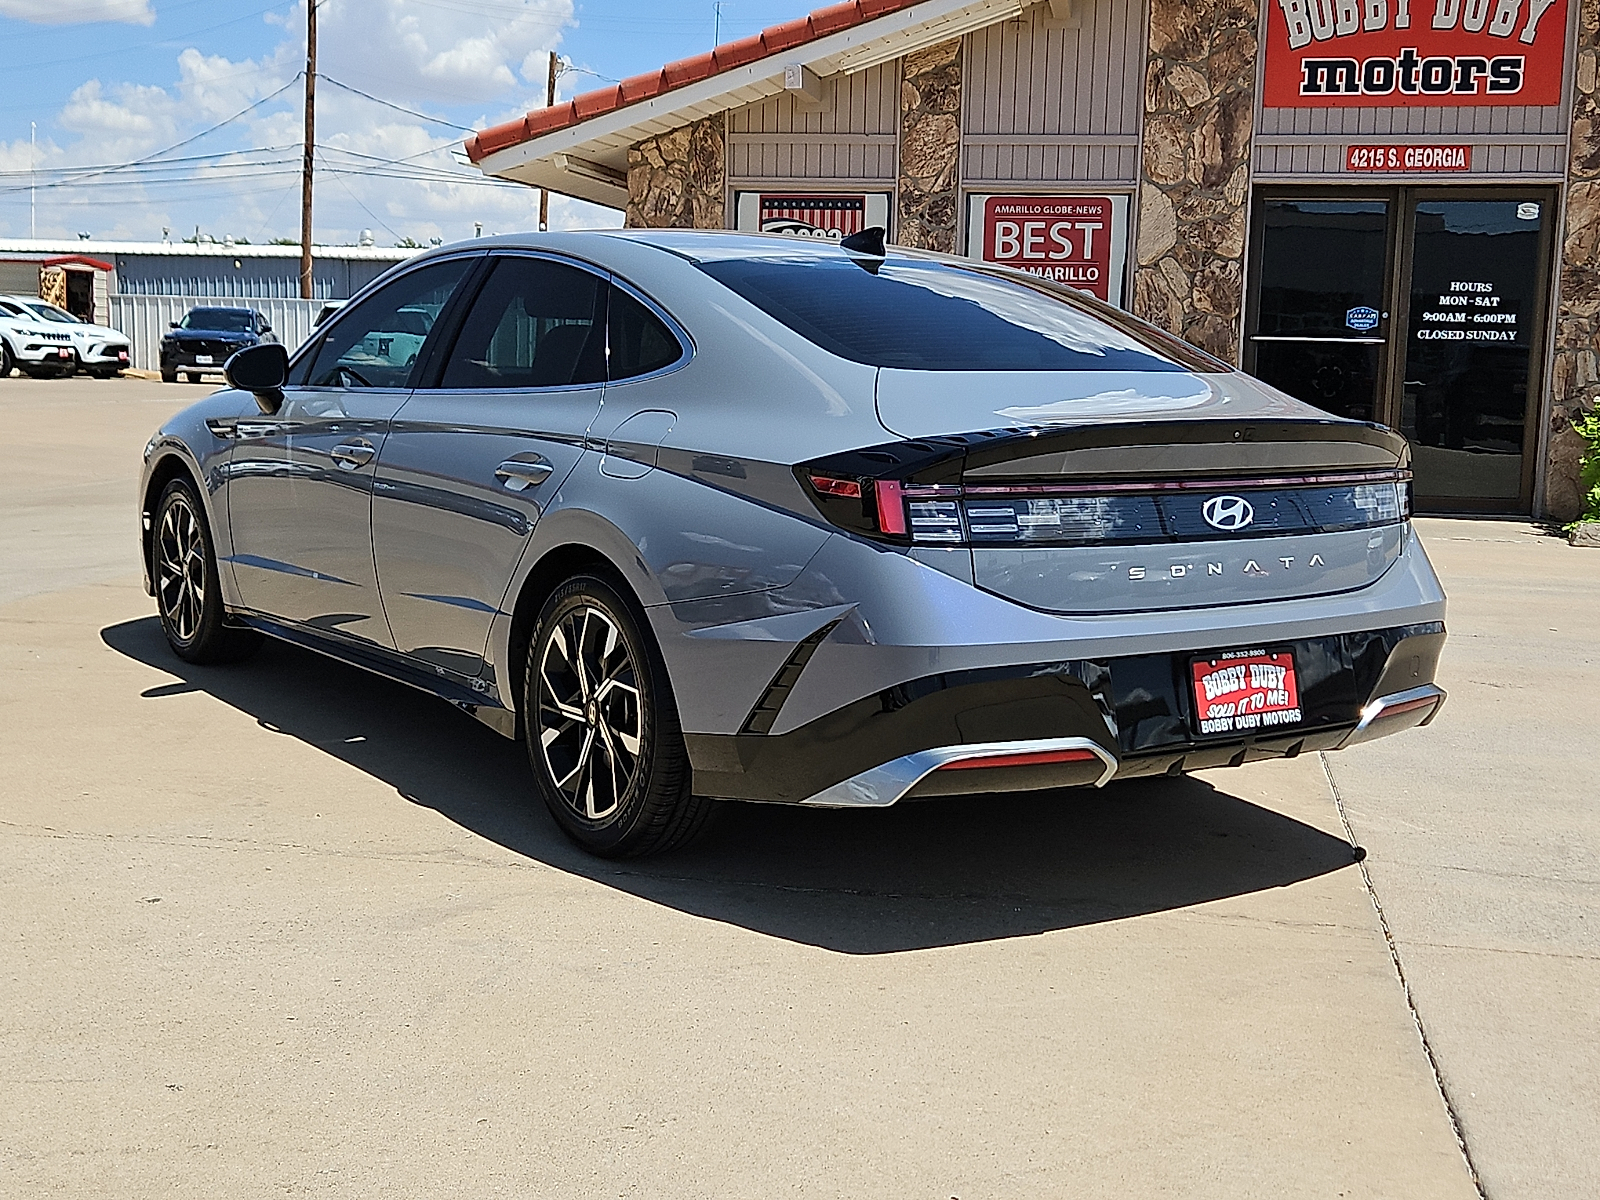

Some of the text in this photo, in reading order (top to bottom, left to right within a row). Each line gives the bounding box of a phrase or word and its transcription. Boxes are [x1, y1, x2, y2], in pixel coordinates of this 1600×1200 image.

[1299, 47, 1525, 96] motors
[1350, 148, 1467, 168] 4215 S. GEORGIA
[994, 205, 1103, 215] AMARILLO GLOBE-NEWS
[994, 221, 1103, 260] BEST
[1450, 281, 1493, 293] HOURS
[1417, 330, 1517, 341] CLOSED SUNDAY
[1128, 554, 1325, 580] SONATA
[1201, 664, 1287, 701] BOBBY DUBY
[1206, 690, 1289, 718] SOLD IT TO ME!
[1201, 709, 1302, 734] BOBBY DUBY MOTORS
